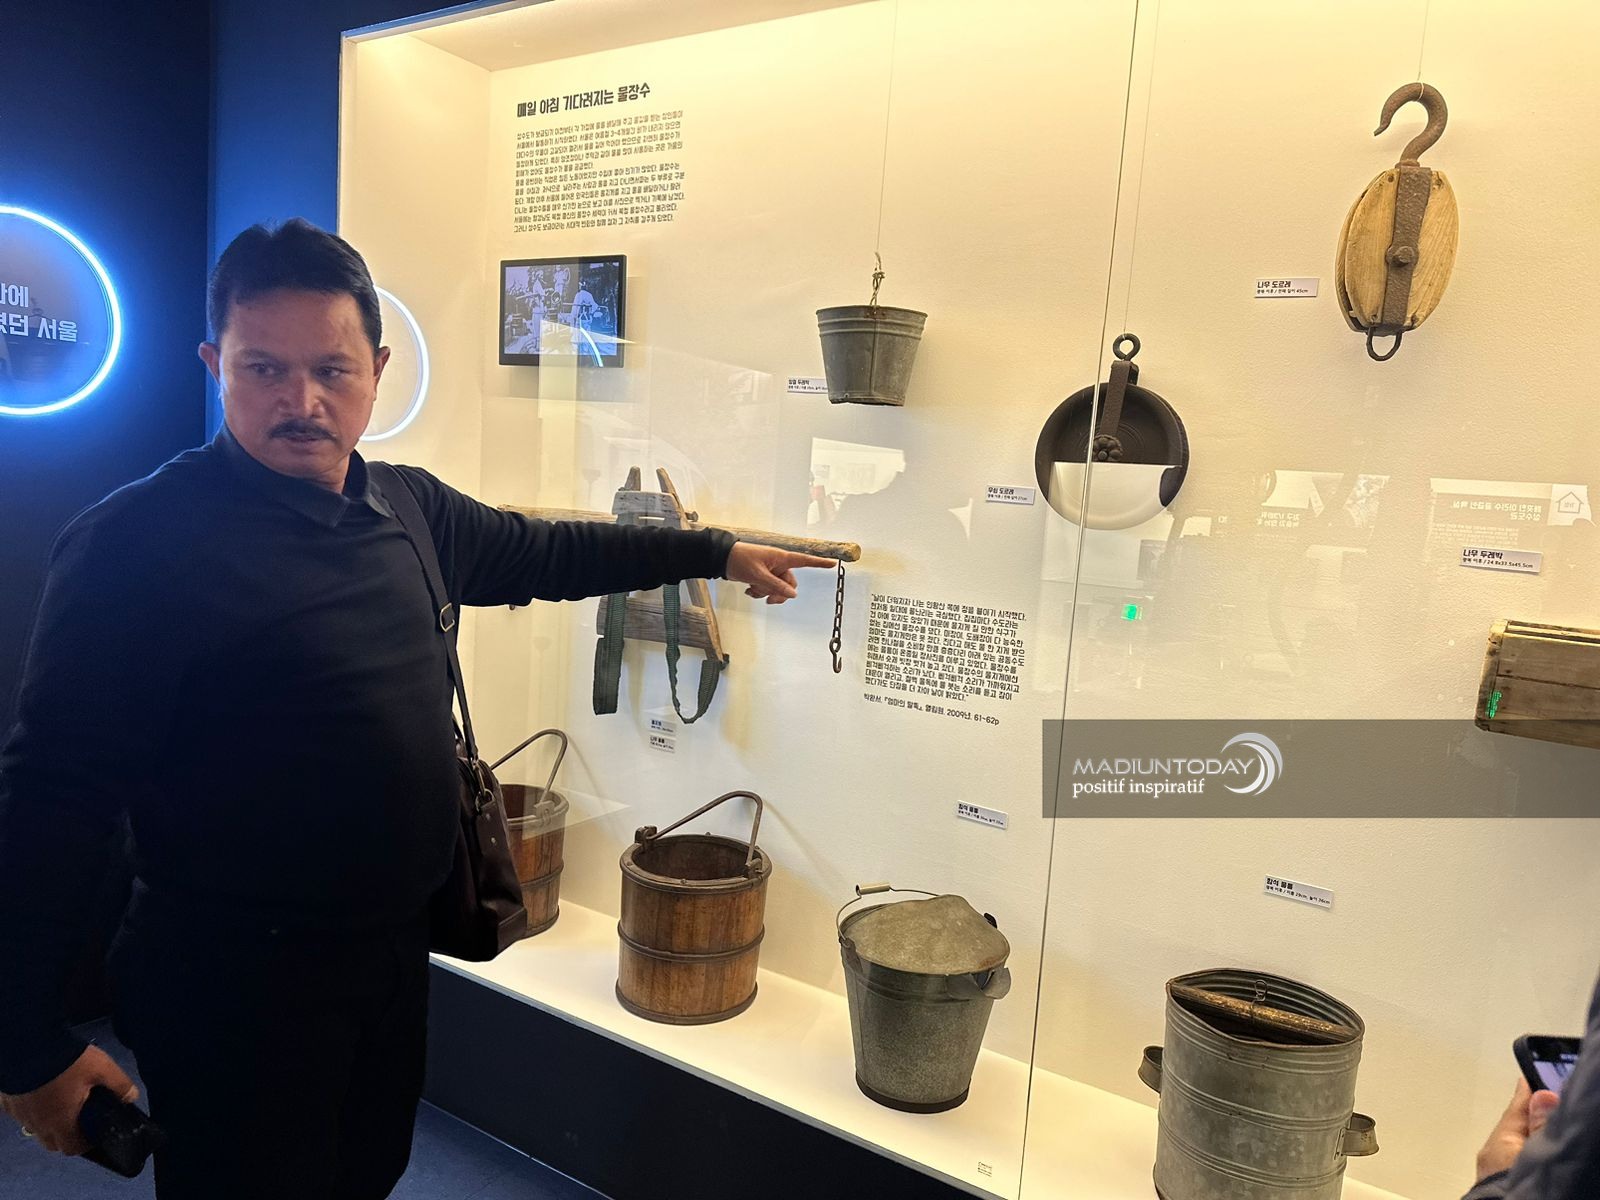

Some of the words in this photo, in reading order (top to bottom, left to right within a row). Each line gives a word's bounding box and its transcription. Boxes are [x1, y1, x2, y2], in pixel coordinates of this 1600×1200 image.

[517, 100, 536, 117] 매일
[540, 97, 559, 114] 아침
[562, 89, 614, 110] 기다려지는
[617, 82, 650, 102] 물장수
[1257, 281, 1271, 289] 나무
[37, 317, 78, 343] 서울
[1463, 549, 1478, 557] 나무
[1480, 550, 1504, 560] 두레박
[886, 595, 910, 606] 더워지자
[911, 599, 924, 607] 나는
[925, 600, 945, 610] 인왕산
[963, 614, 990, 625] 집집마다
[991, 618, 1018, 630] 수도라는
[993, 636, 1001, 644] 다
[995, 627, 1016, 639] 식구가
[868, 626, 886, 636] 엄마도
[995, 645, 1009, 655] 지게
[966, 658, 988, 670] 있었다.
[989, 662, 1016, 674] 물장수를
[982, 652, 996, 662] 있는
[997, 654, 1025, 666] 공동수도
[902, 665, 921, 676] 소리가
[964, 676, 985, 687] 소리가
[985, 679, 1020, 693] 가까워지고
[957, 666, 983, 678] 물장수의
[908, 683, 915, 692] 더
[961, 684, 981, 695] 소리를
